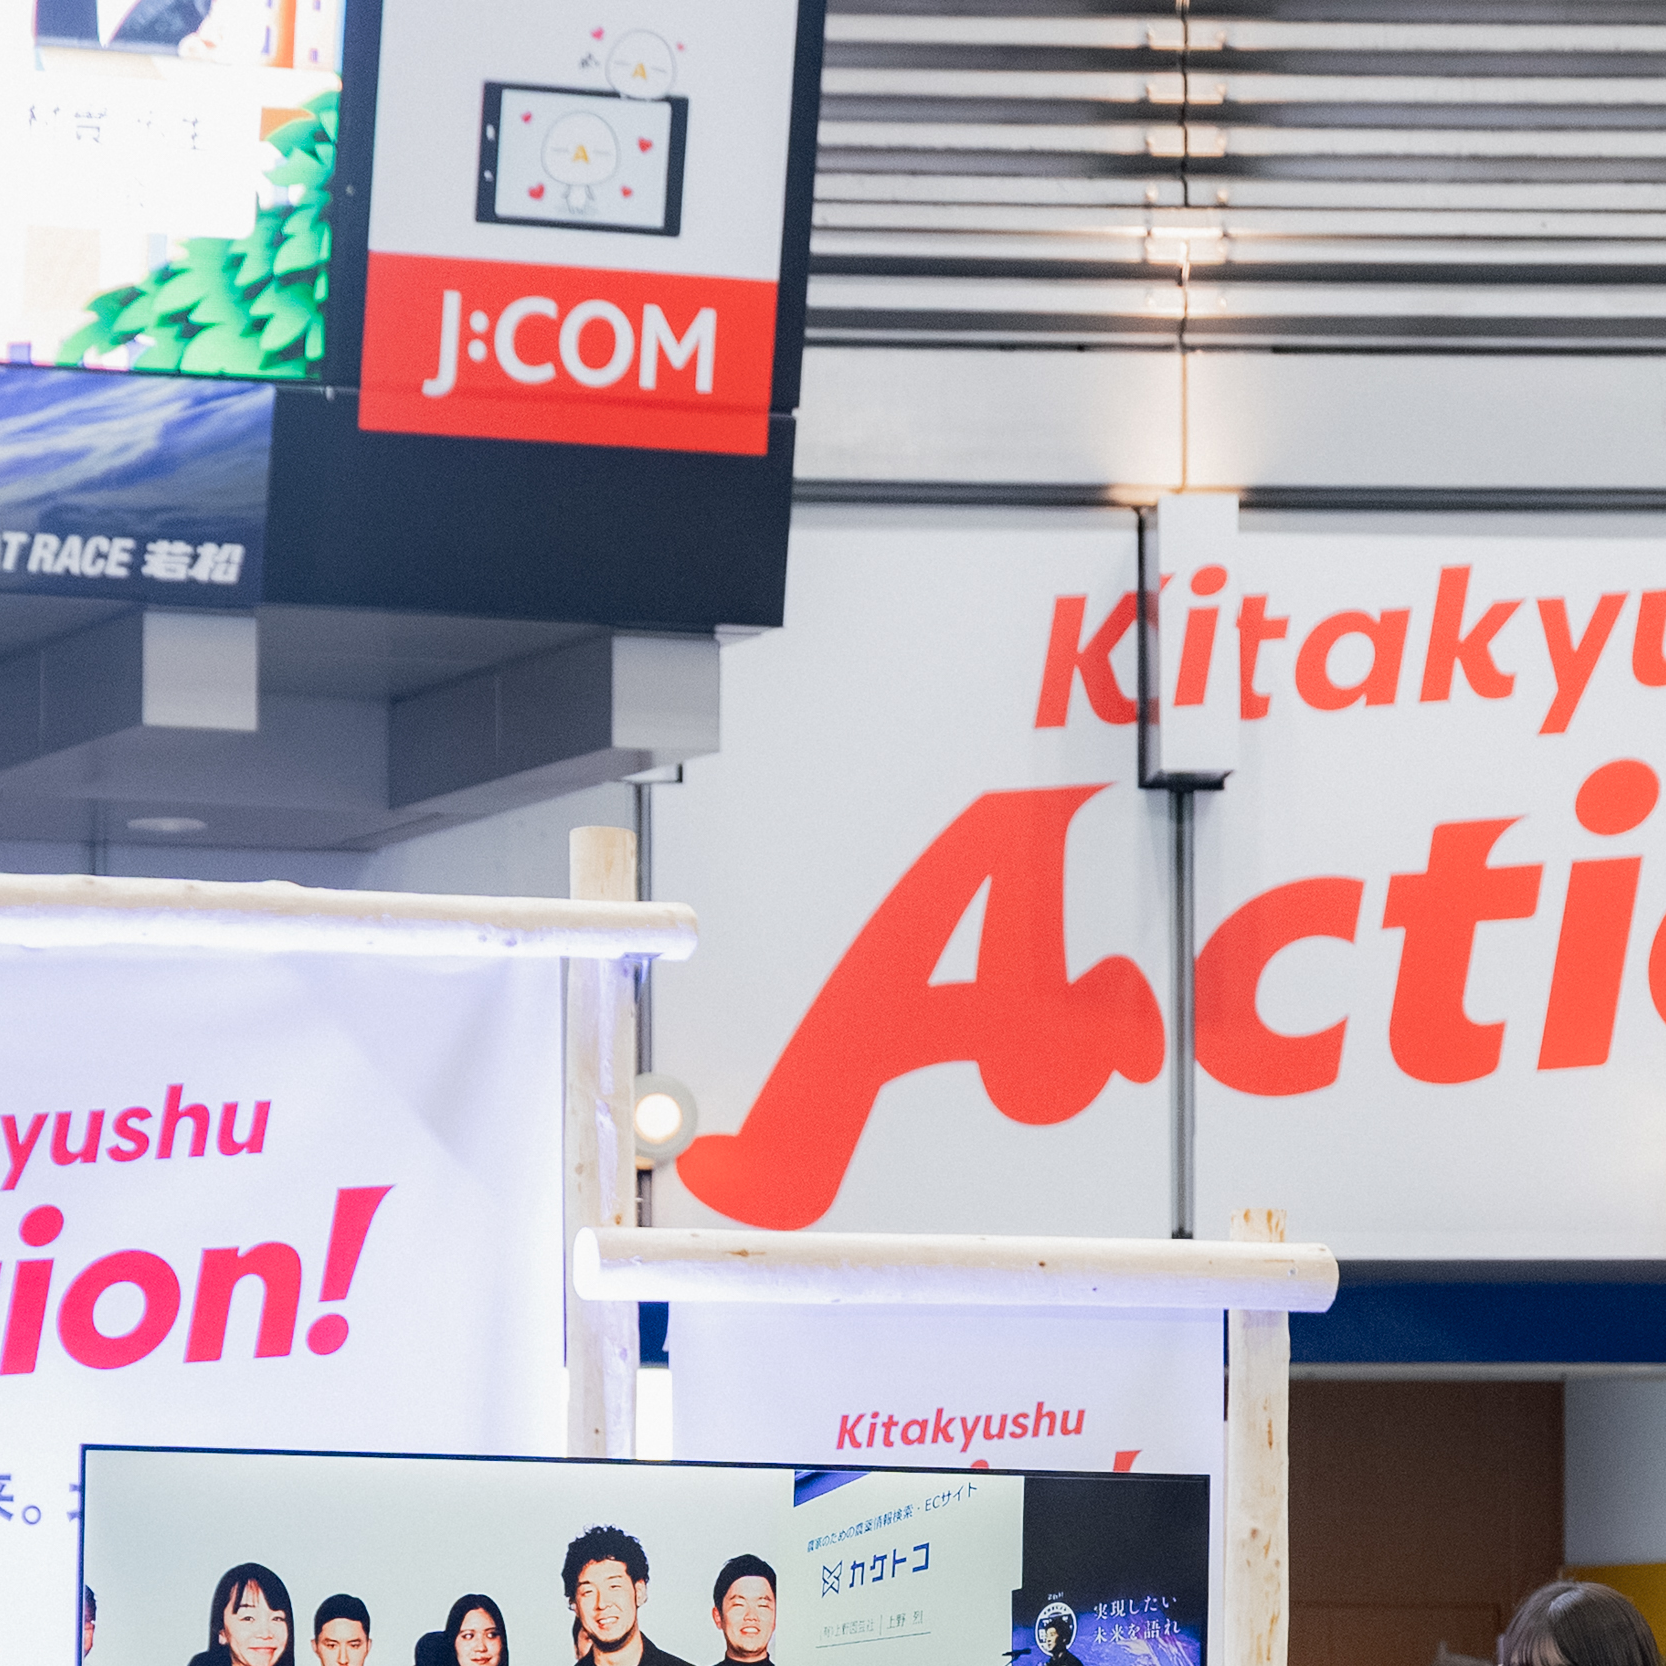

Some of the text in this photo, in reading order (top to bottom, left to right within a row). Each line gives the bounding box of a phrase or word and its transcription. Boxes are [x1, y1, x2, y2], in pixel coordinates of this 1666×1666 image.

[422, 290, 717, 397] J:COM
[27, 533, 134, 579] RACE
[141, 541, 243, 587] 若松
[835, 1400, 1086, 1453] Kitakyushu
[849, 1542, 930, 1589] カケトコ
[1093, 1595, 1177, 1621] 実現したい
[1093, 1618, 1181, 1645] 未来を語れ
